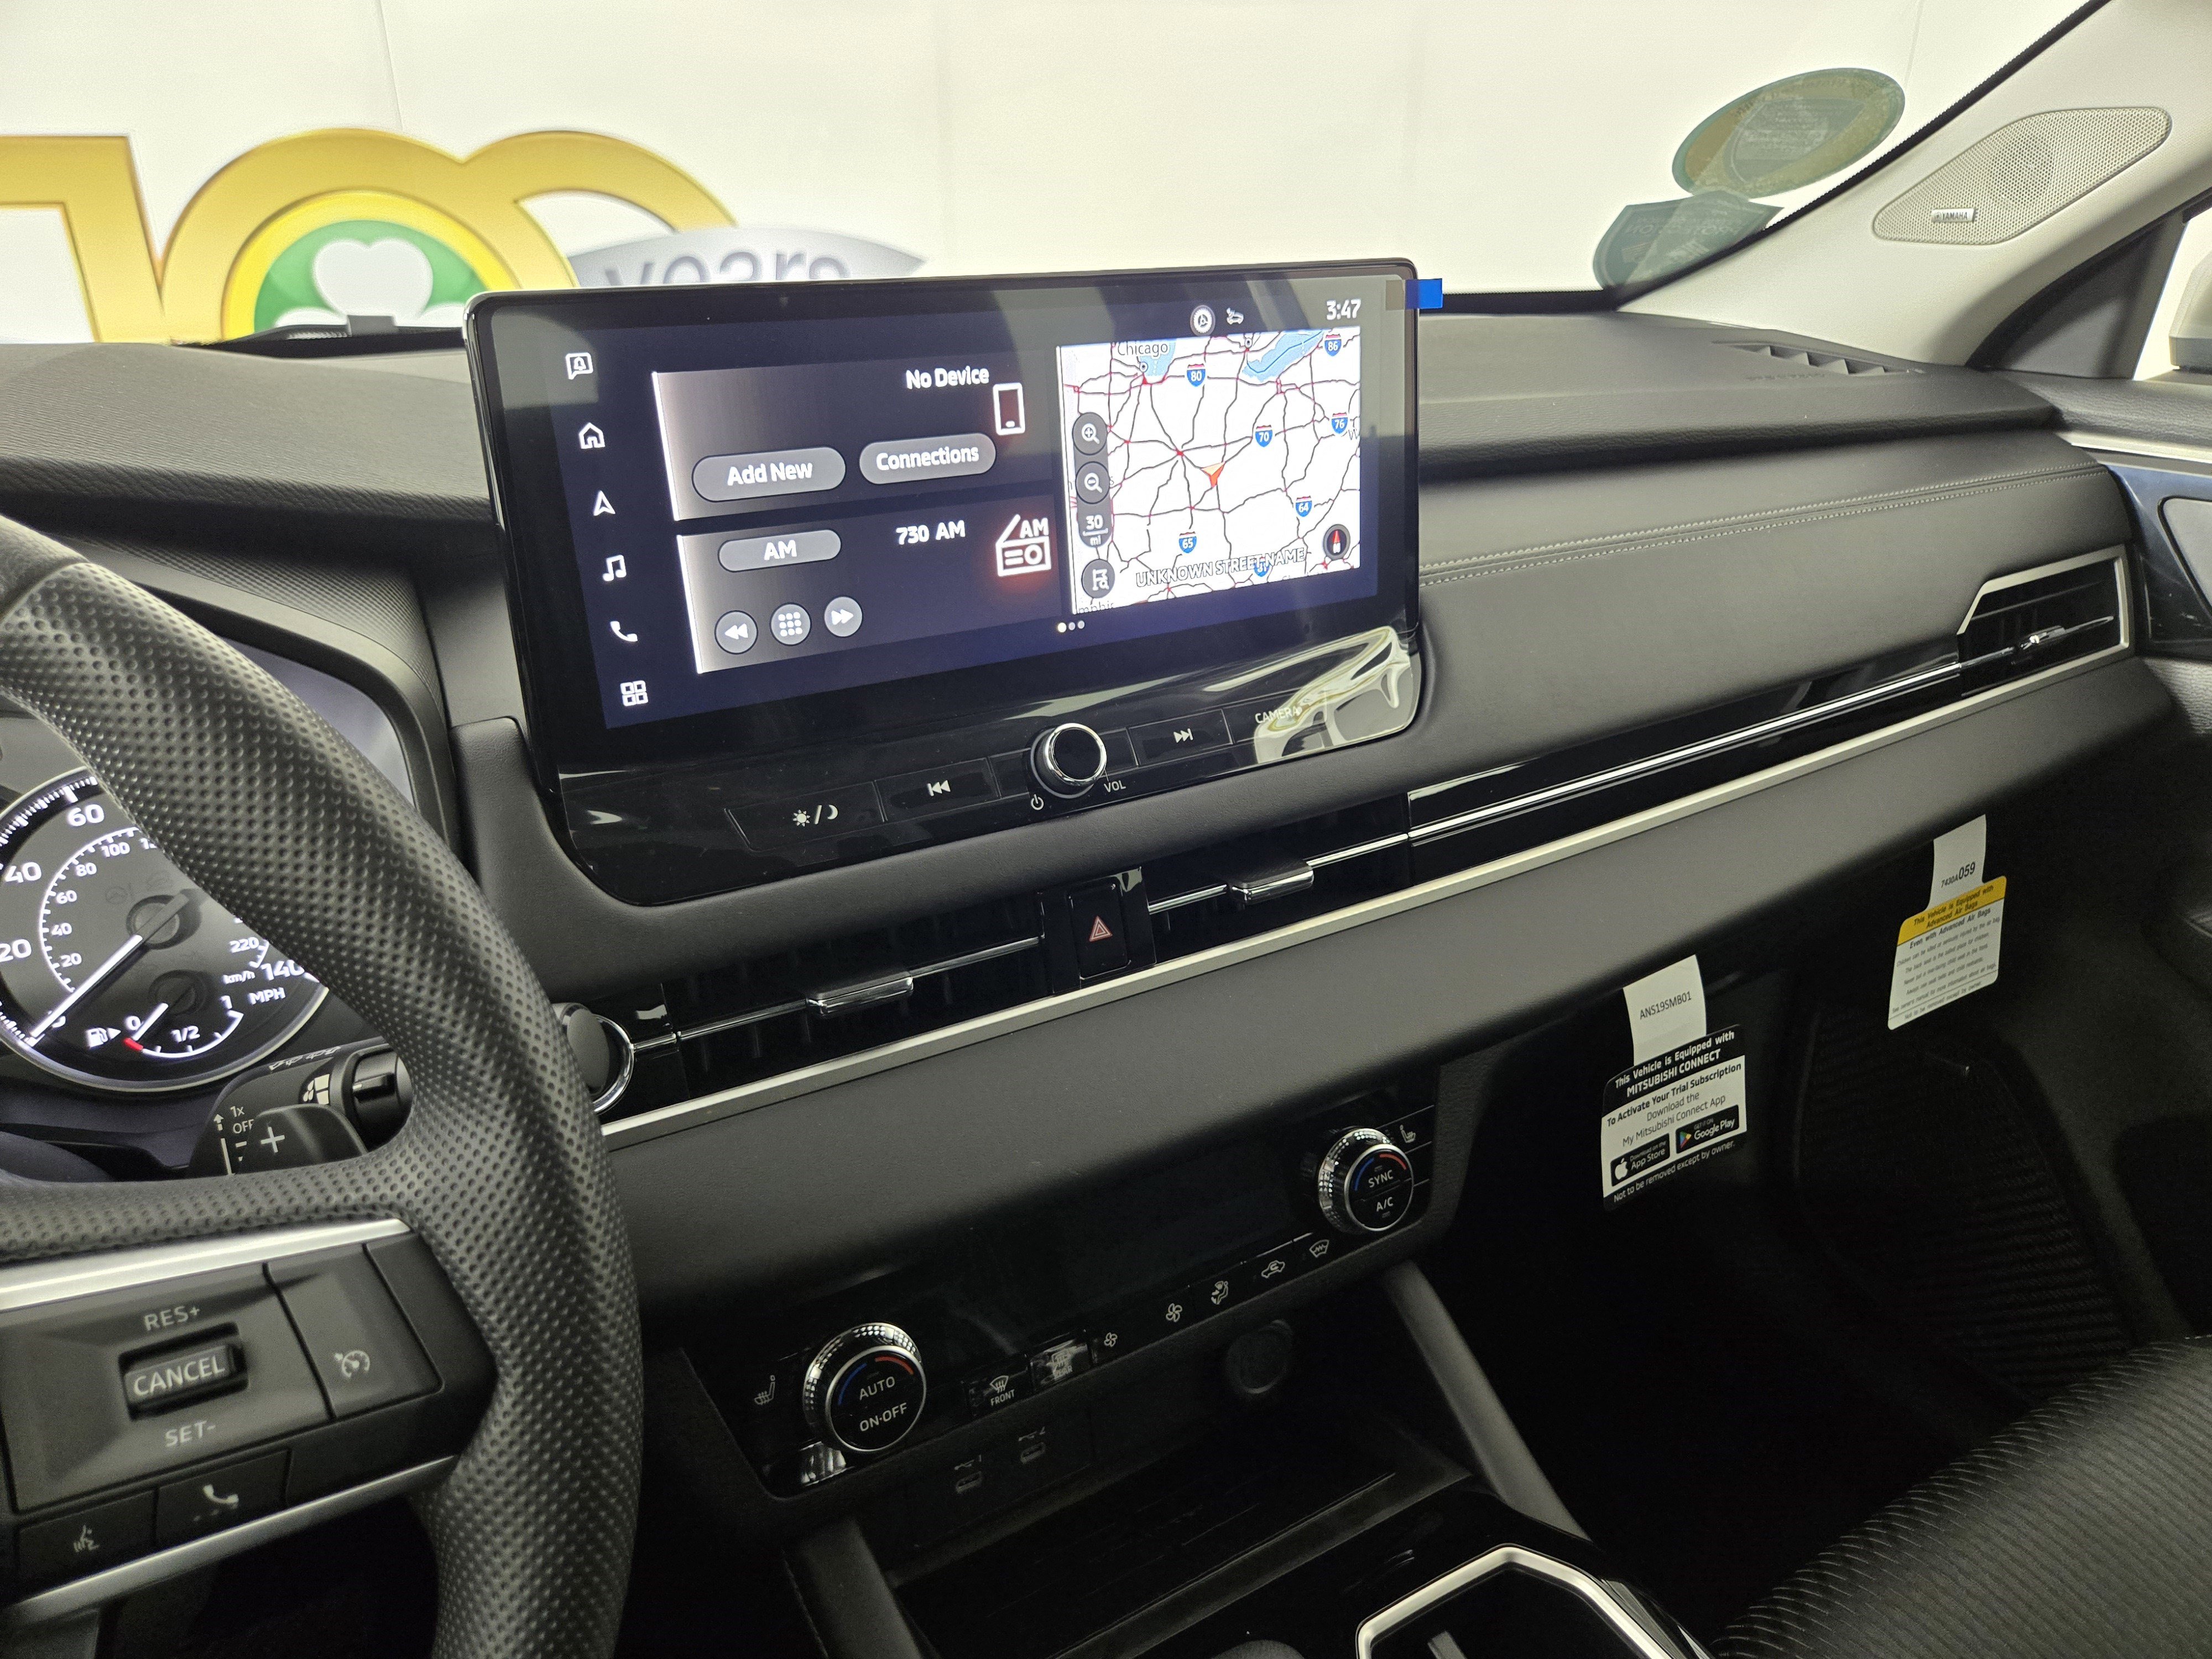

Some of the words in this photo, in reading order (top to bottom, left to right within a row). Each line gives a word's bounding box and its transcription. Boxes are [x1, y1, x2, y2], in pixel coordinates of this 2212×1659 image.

[1942, 211, 1968, 221] YAMAHA
[1326, 299, 1362, 320] 3:47
[1117, 341, 1169, 358] Chicago
[1328, 341, 1339, 351] 86
[906, 369, 932, 389] No
[935, 366, 990, 387] Device
[1190, 372, 1202, 382] 80
[1334, 419, 1345, 430] 76
[1259, 432, 1269, 442] 70
[876, 446, 979, 471] Connections
[727, 465, 768, 487] Add
[772, 462, 813, 481] New
[1298, 503, 1309, 513] 64
[1020, 518, 1049, 539] AM
[1086, 515, 1104, 530] 30
[896, 524, 930, 545] 730
[935, 520, 966, 540] AM
[764, 540, 797, 561] AM
[1182, 538, 1193, 549] 65
[1135, 561, 1213, 588] UNKNOWN
[1215, 554, 1263, 575] STREET
[1265, 547, 1306, 568] NAME
[1255, 707, 1300, 724] CAMERA
[1104, 780, 1126, 793] VOL
[66, 804, 105, 827] 60
[101, 842, 131, 858] 100
[4, 862, 41, 883] 40
[75, 862, 97, 877] 80
[56, 890, 77, 905] 60
[1914, 915, 1924, 926] This
[1927, 906, 1947, 919] Vehicle
[1956, 890, 1980, 906] Equipped
[1982, 885, 1994, 896] with
[1927, 911, 1953, 929] Advanced
[1954, 907, 1963, 916] Air
[1965, 900, 1978, 911] Bags
[51, 922, 72, 937] 40
[1910, 938, 1923, 949] Even
[1926, 932, 1937, 942] with
[1939, 918, 1965, 936] Advanced
[1967, 914, 1975, 923] Air
[1977, 907, 1991, 919] Bags
[229, 937, 259, 953] 220
[60, 953, 82, 968] 20
[260, 959, 305, 980] 140
[222, 971, 255, 985] km/h
[221, 995, 233, 1009] 1
[249, 987, 286, 1005] MPH
[1640, 991, 1692, 1020] ANS19SMB01
[125, 1016, 142, 1030] 0
[171, 1026, 200, 1042] 1/2
[1615, 1073, 1630, 1089] This
[1632, 1061, 1662, 1079] Vehicle
[1665, 1056, 1672, 1066] is
[1674, 1037, 1712, 1062] Equipped
[1715, 1030, 1735, 1046] with
[1626, 1067, 1677, 1098] MITSUBISHI
[1678, 1048, 1721, 1074] CONNECT
[1607, 1118, 1616, 1127] To
[1618, 1102, 1650, 1122] Activate
[1652, 1091, 1670, 1104] Your
[1671, 1082, 1688, 1097] Trial
[1690, 1062, 1741, 1089] Subscription
[230, 1105, 245, 1118] 1x
[1647, 1099, 1684, 1122] Download
[1686, 1092, 1700, 1103] the
[232, 1119, 255, 1134] OFF
[1623, 1136, 1634, 1147] My
[1636, 1115, 1675, 1141] Mitsubishi
[1676, 1104, 1709, 1121] Connect
[1709, 1095, 1726, 1108] App
[1694, 1124, 1720, 1141] Google
[1720, 1118, 1735, 1132] Play
[1631, 1157, 1646, 1171] App
[1647, 1147, 1666, 1162] Store
[1368, 1170, 1394, 1188] SYNC
[1614, 1192, 1627, 1203] Not
[1627, 1186, 1635, 1196] to
[1636, 1181, 1645, 1191] be
[1646, 1165, 1676, 1186] removed
[1677, 1155, 1700, 1170] except
[1701, 1150, 1710, 1160] by
[1712, 1140, 1735, 1156] owner.
[1376, 1196, 1394, 1212] A/C
[143, 1305, 201, 1331] RES+
[133, 1354, 226, 1397] CANCEL
[859, 1375, 896, 1401] AUTO
[990, 1389, 1015, 1406] FRONT
[164, 1420, 216, 1448] SET-
